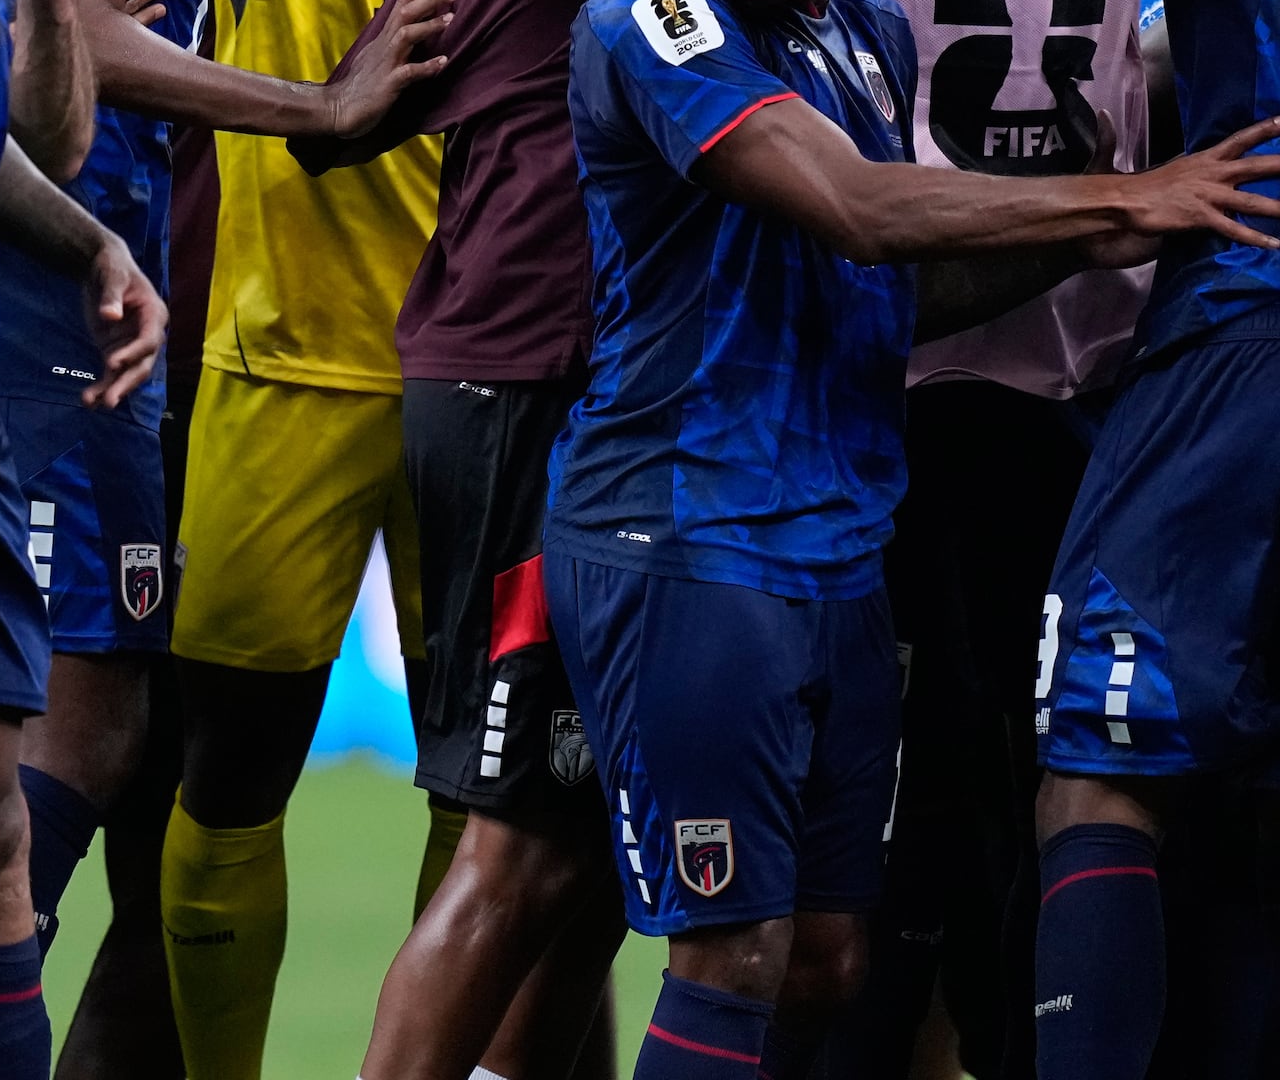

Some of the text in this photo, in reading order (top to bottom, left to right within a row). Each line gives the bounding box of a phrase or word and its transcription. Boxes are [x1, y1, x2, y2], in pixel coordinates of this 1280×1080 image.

[674, 23, 692, 35] FIFA
[676, 37, 708, 56] 2026
[983, 123, 1067, 158] FIFA
[125, 547, 158, 561] FCF
[680, 824, 726, 838] FCF
